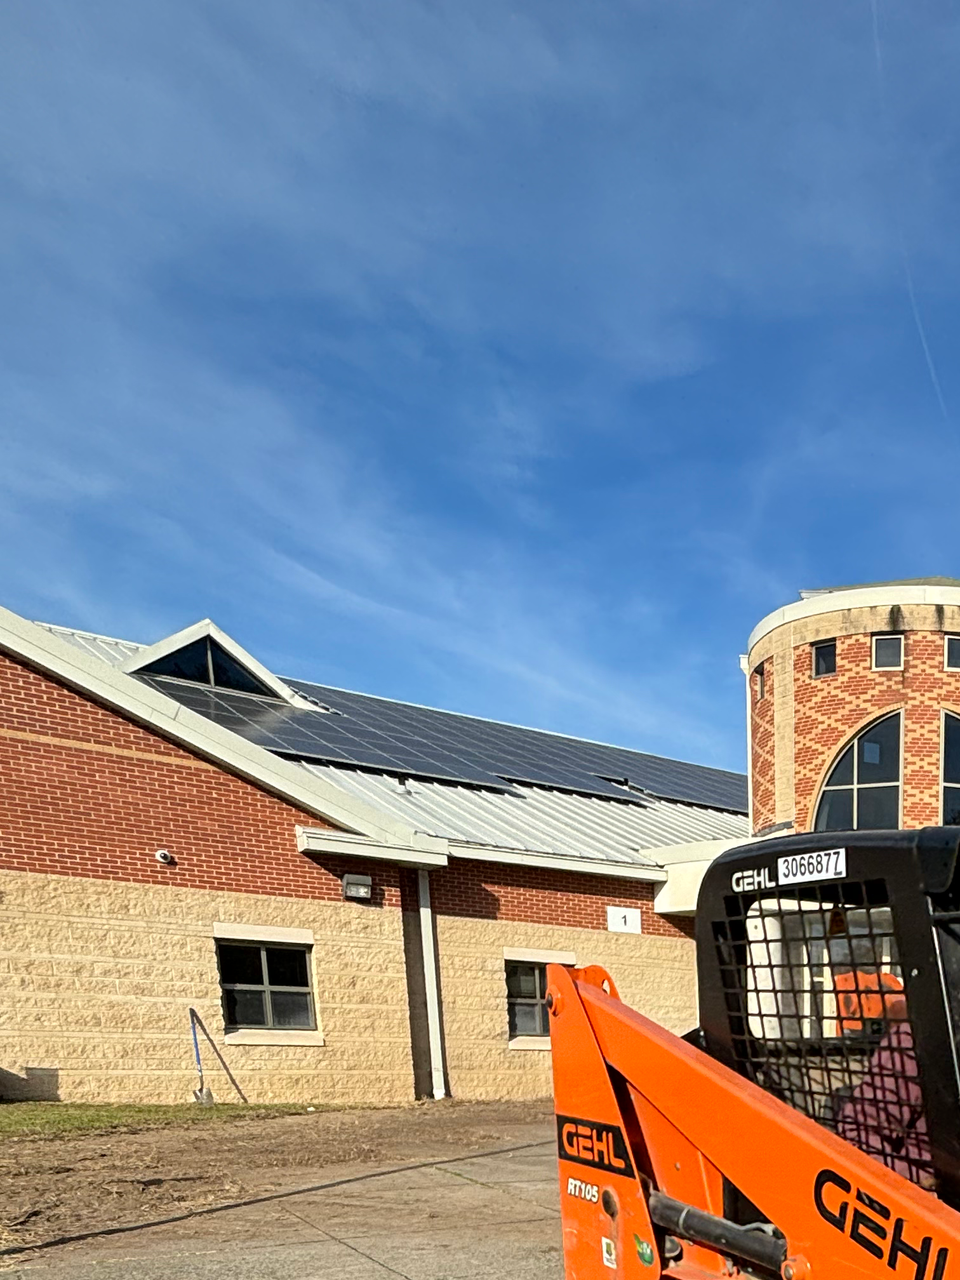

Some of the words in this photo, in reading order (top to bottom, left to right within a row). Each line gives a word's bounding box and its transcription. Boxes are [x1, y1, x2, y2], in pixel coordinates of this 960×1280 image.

[783, 851, 843, 879] 3066877
[731, 867, 776, 893] GEHL
[621, 914, 627, 926] 1
[562, 1123, 626, 1169] GEHL
[567, 1178, 599, 1204] RT105
